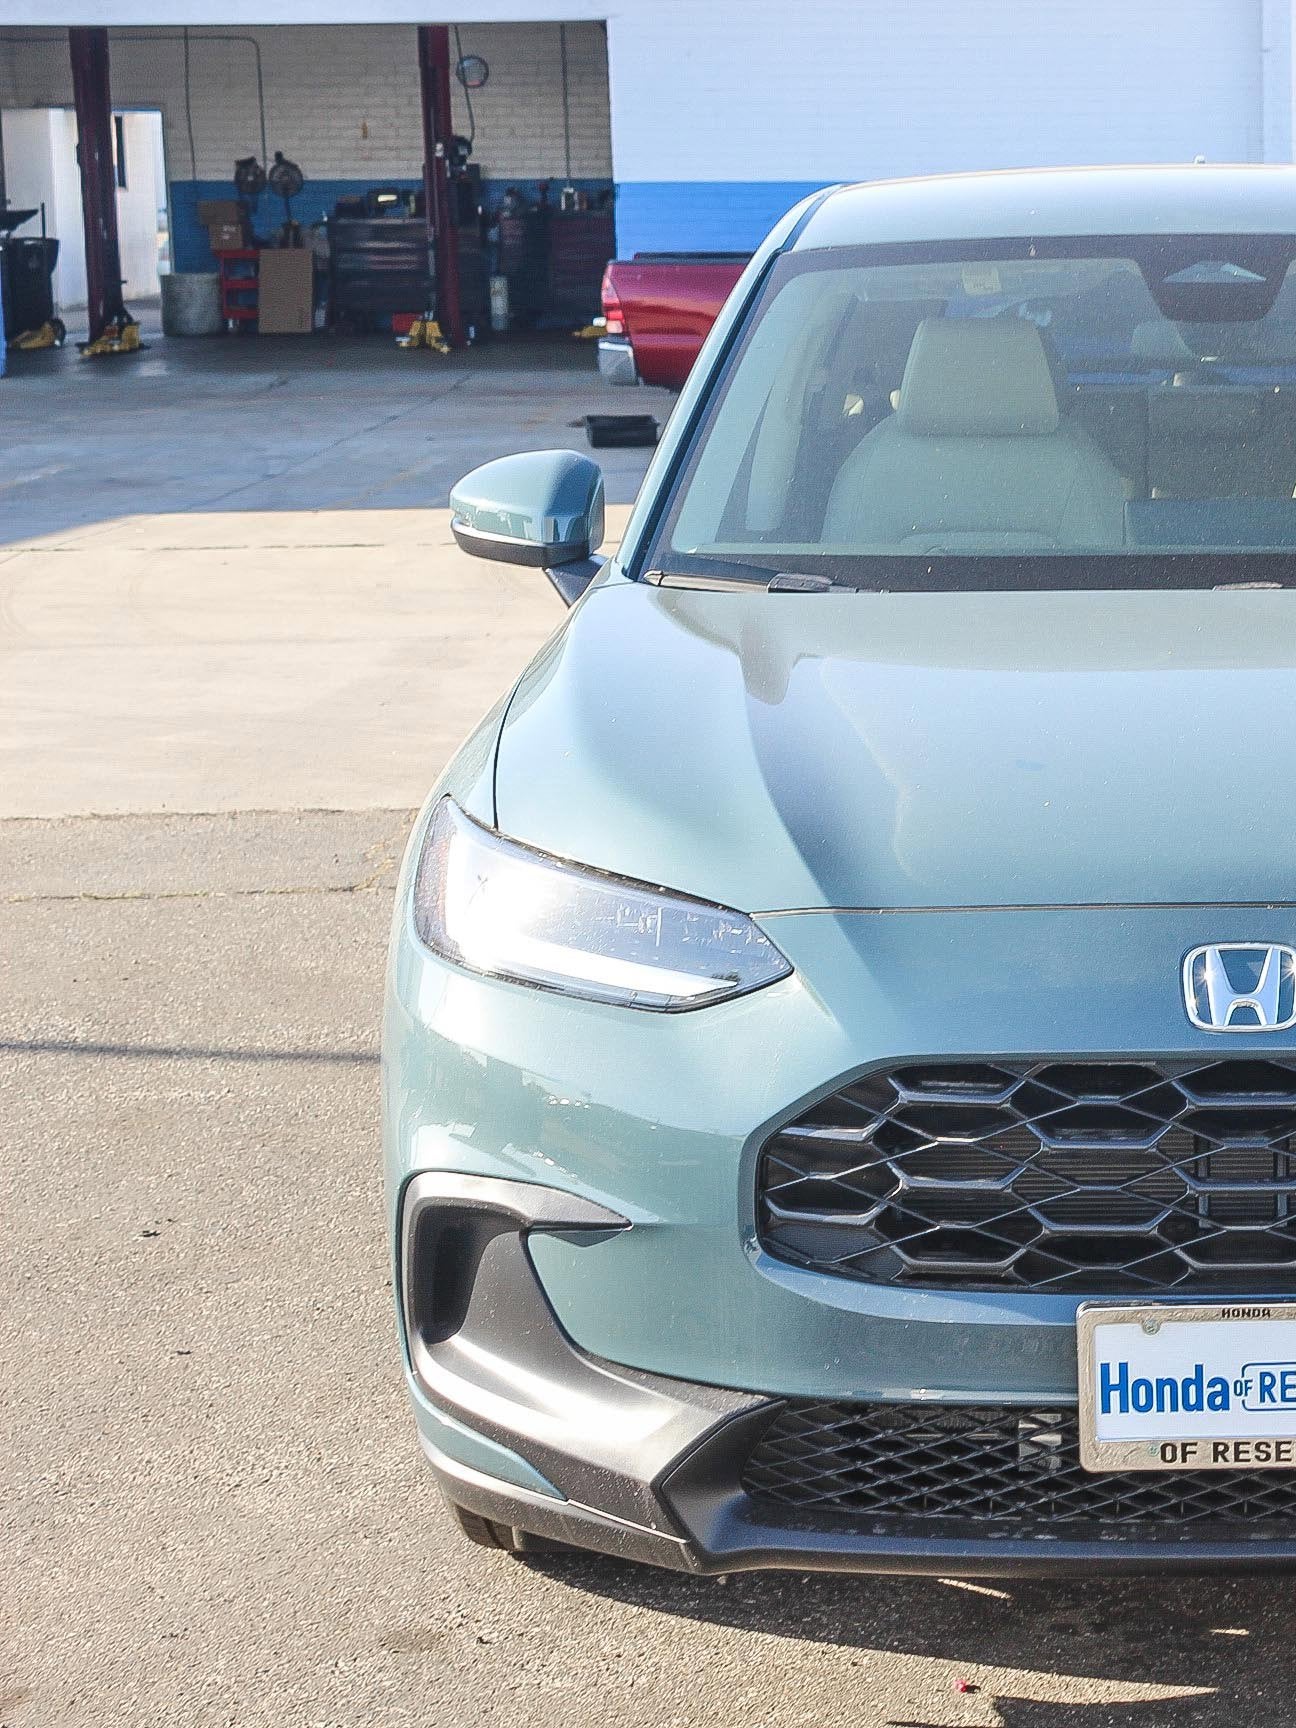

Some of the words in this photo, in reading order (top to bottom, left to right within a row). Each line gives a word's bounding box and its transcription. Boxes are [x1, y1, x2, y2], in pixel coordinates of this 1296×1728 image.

[1221, 1307, 1271, 1319] HONDA
[1100, 1361, 1231, 1415] Honda
[1233, 1379, 1253, 1397] OF
[1159, 1441, 1198, 1464] OF
